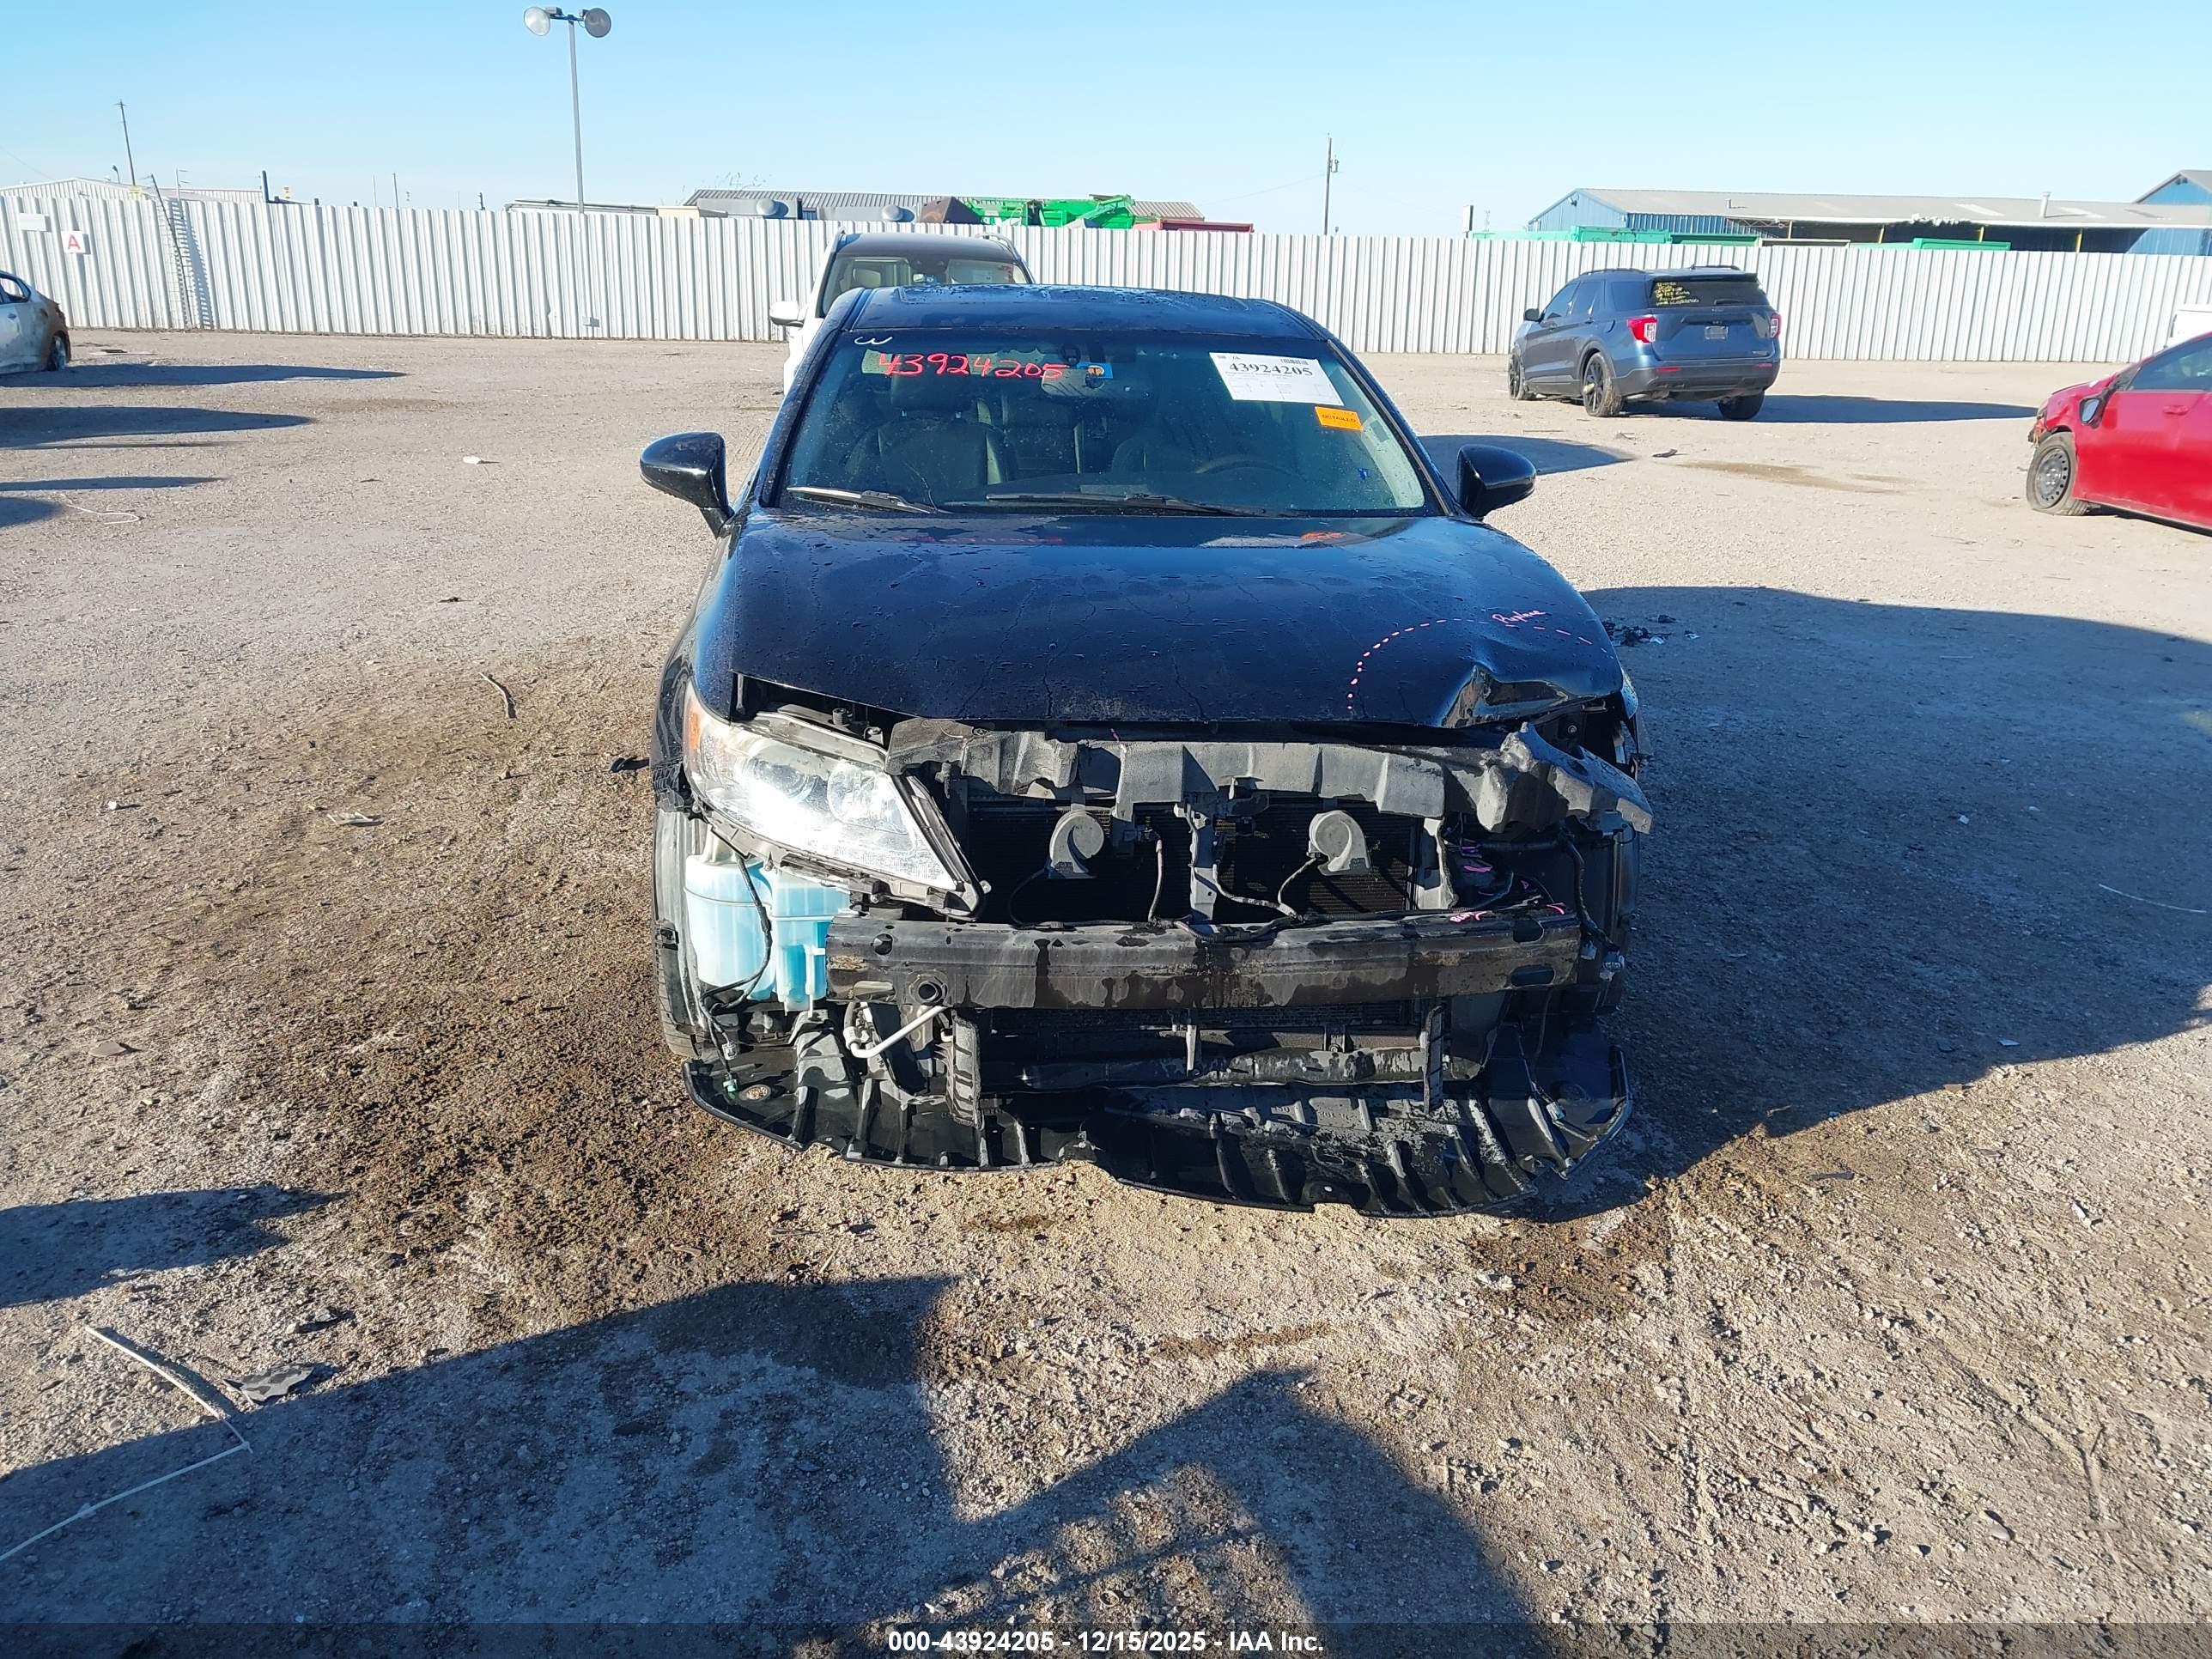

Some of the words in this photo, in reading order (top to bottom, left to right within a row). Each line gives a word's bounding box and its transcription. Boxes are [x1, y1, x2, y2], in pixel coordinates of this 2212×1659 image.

[67, 234, 81, 250] A
[878, 353, 1071, 379] 43924205
[1230, 362, 1313, 376] 43924205
